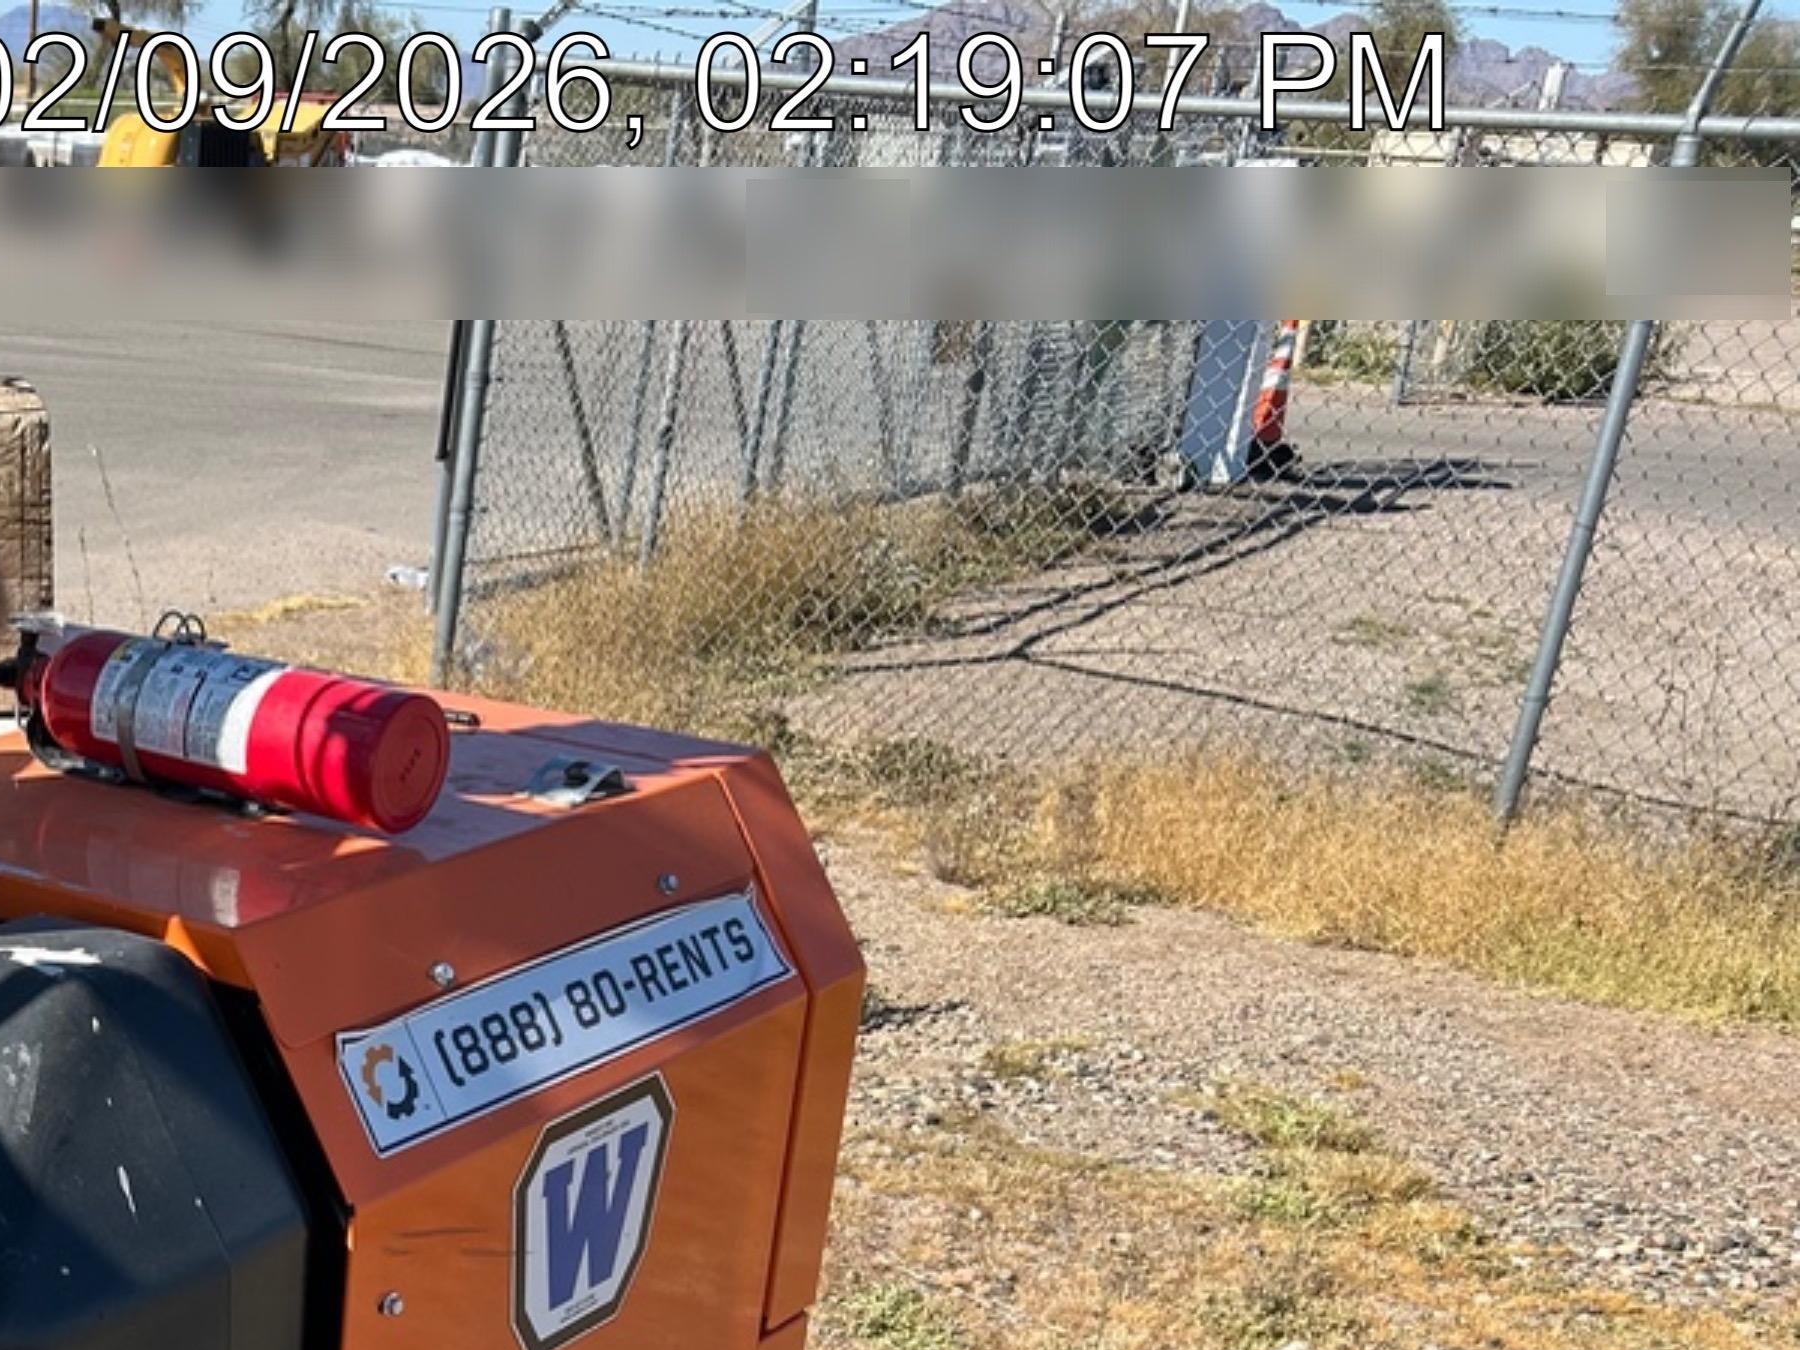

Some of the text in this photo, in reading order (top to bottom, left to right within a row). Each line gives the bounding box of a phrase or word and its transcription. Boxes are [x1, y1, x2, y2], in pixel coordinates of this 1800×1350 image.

[433, 917, 755, 1089] (888) 80-RENTS
[543, 1121, 649, 1311] W
